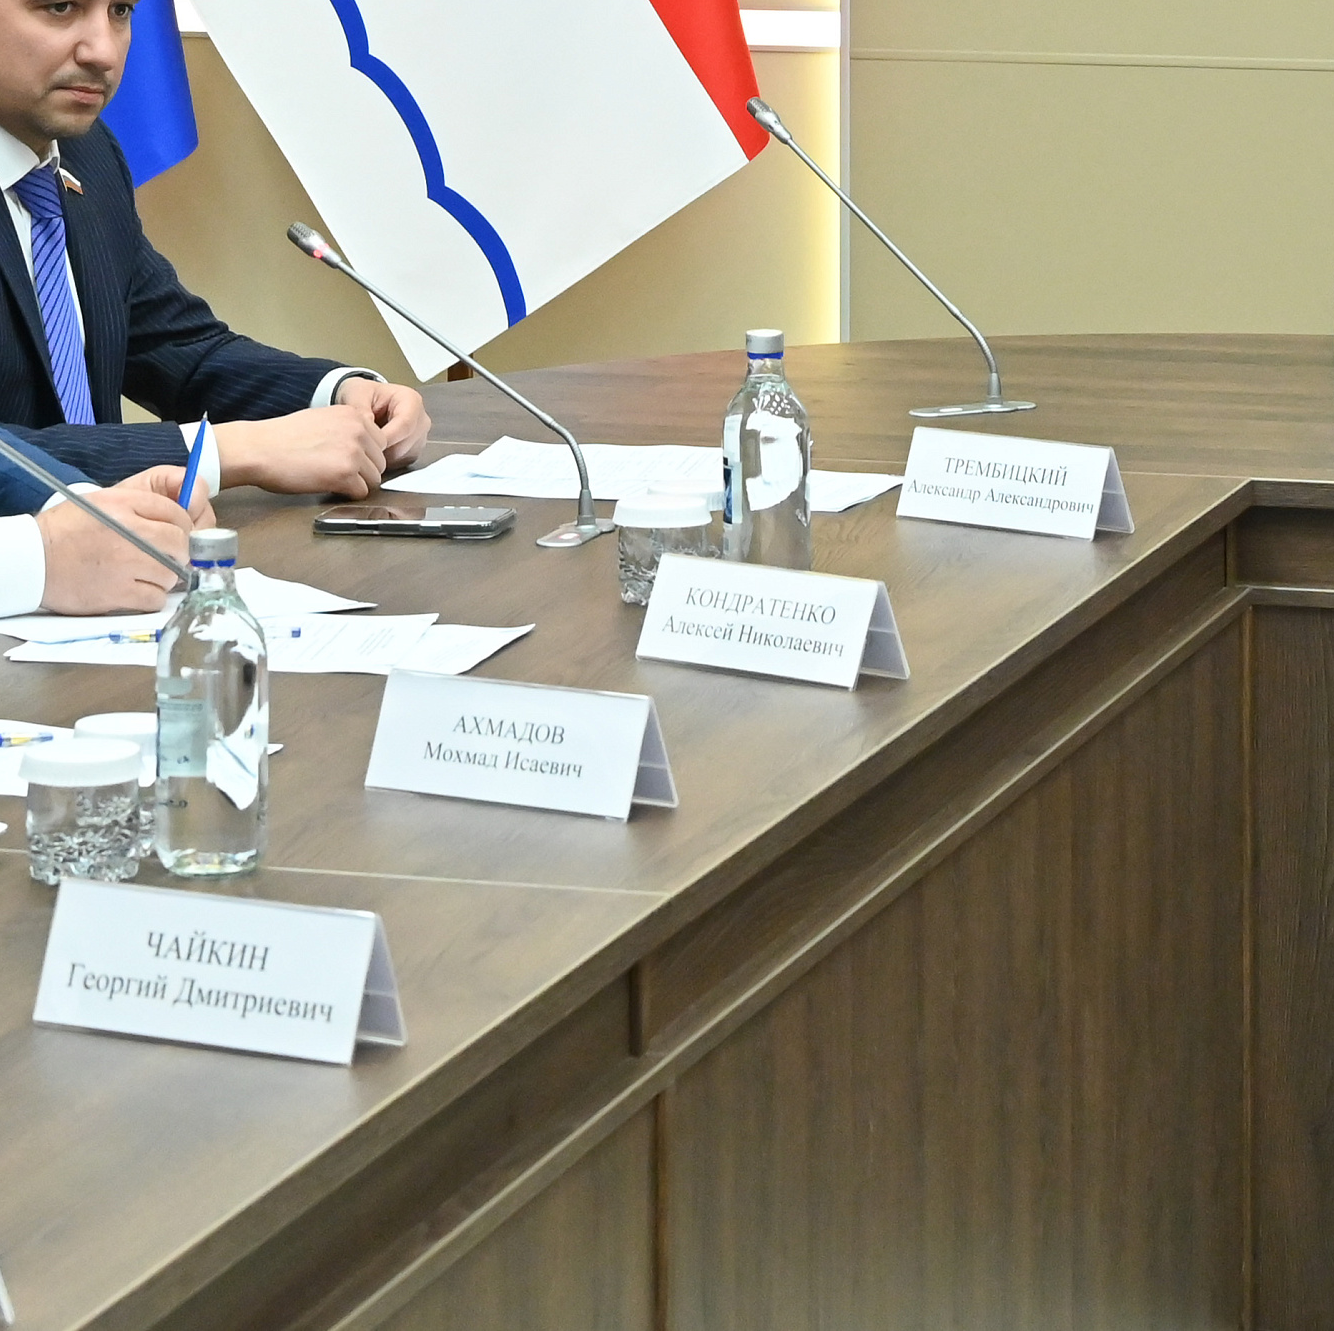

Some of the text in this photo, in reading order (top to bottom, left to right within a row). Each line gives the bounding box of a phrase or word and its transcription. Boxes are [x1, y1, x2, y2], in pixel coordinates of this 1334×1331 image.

[944, 456, 1069, 487] ТРЕМБИЦКИЙ
[907, 478, 1095, 514] Александр Александрович
[685, 587, 837, 626] КОНДРАТЕНКО
[661, 615, 845, 658] Алексей Николаевич
[452, 715, 566, 745] АХМАДОВ
[422, 741, 584, 779] Мохмад Исаевич
[147, 930, 272, 973] ЧАЙКИН
[66, 962, 334, 1024] Георгий Дмитриевич
